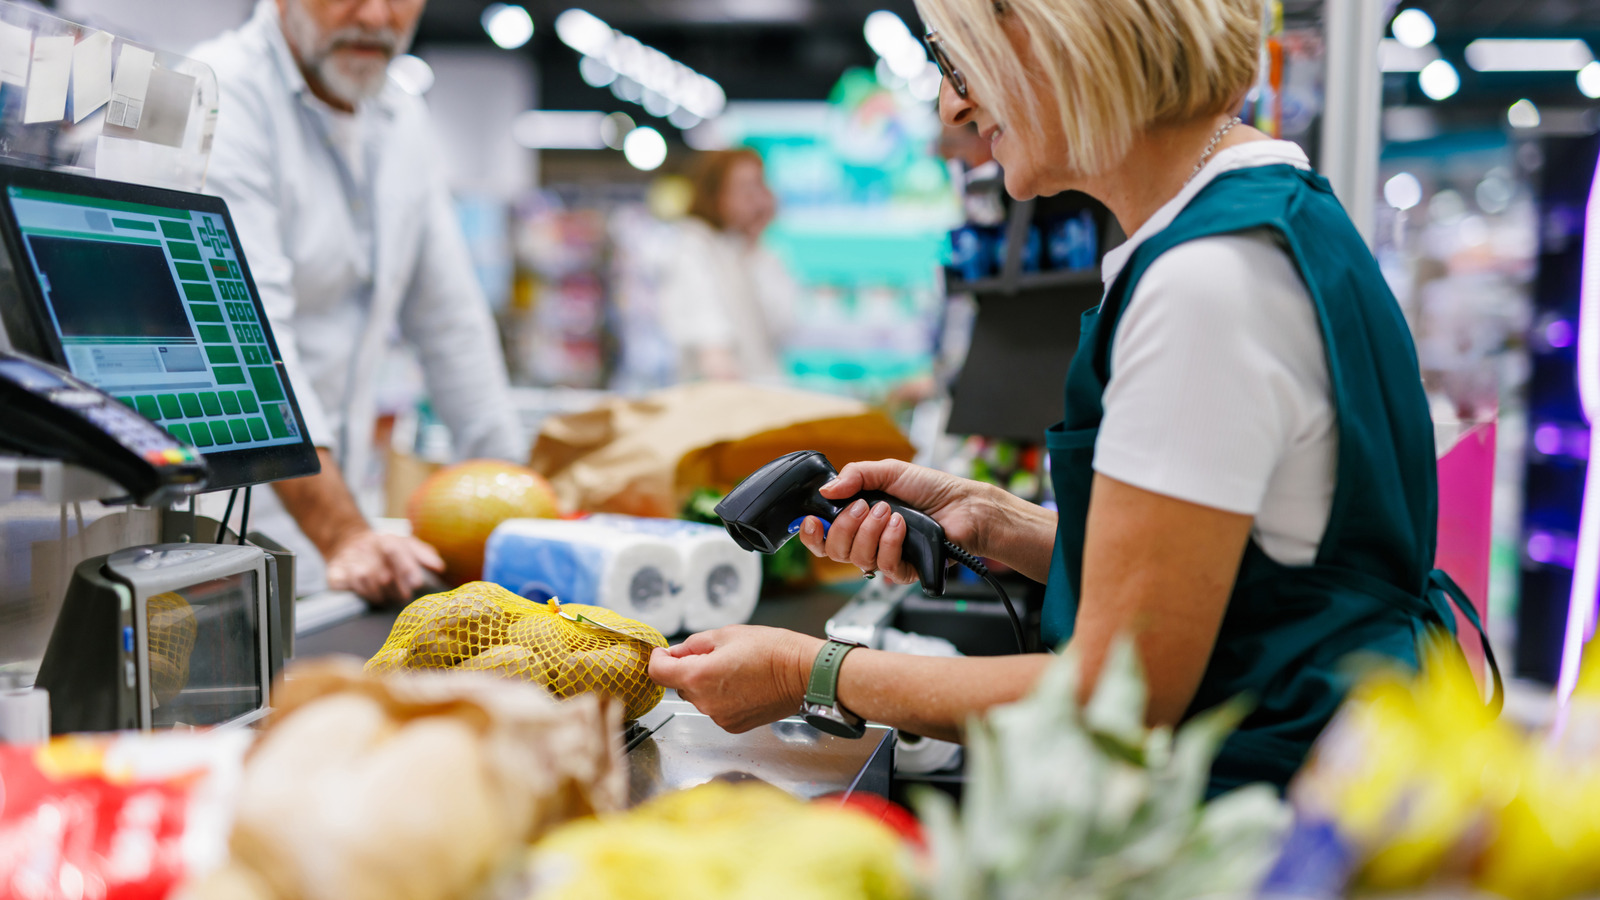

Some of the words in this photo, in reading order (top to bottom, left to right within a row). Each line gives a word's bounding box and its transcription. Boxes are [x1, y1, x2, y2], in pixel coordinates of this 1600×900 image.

[220, 285, 226, 294] 7
[229, 307, 235, 316] 4
[236, 328, 242, 338] 1
[245, 328, 251, 338] 2
